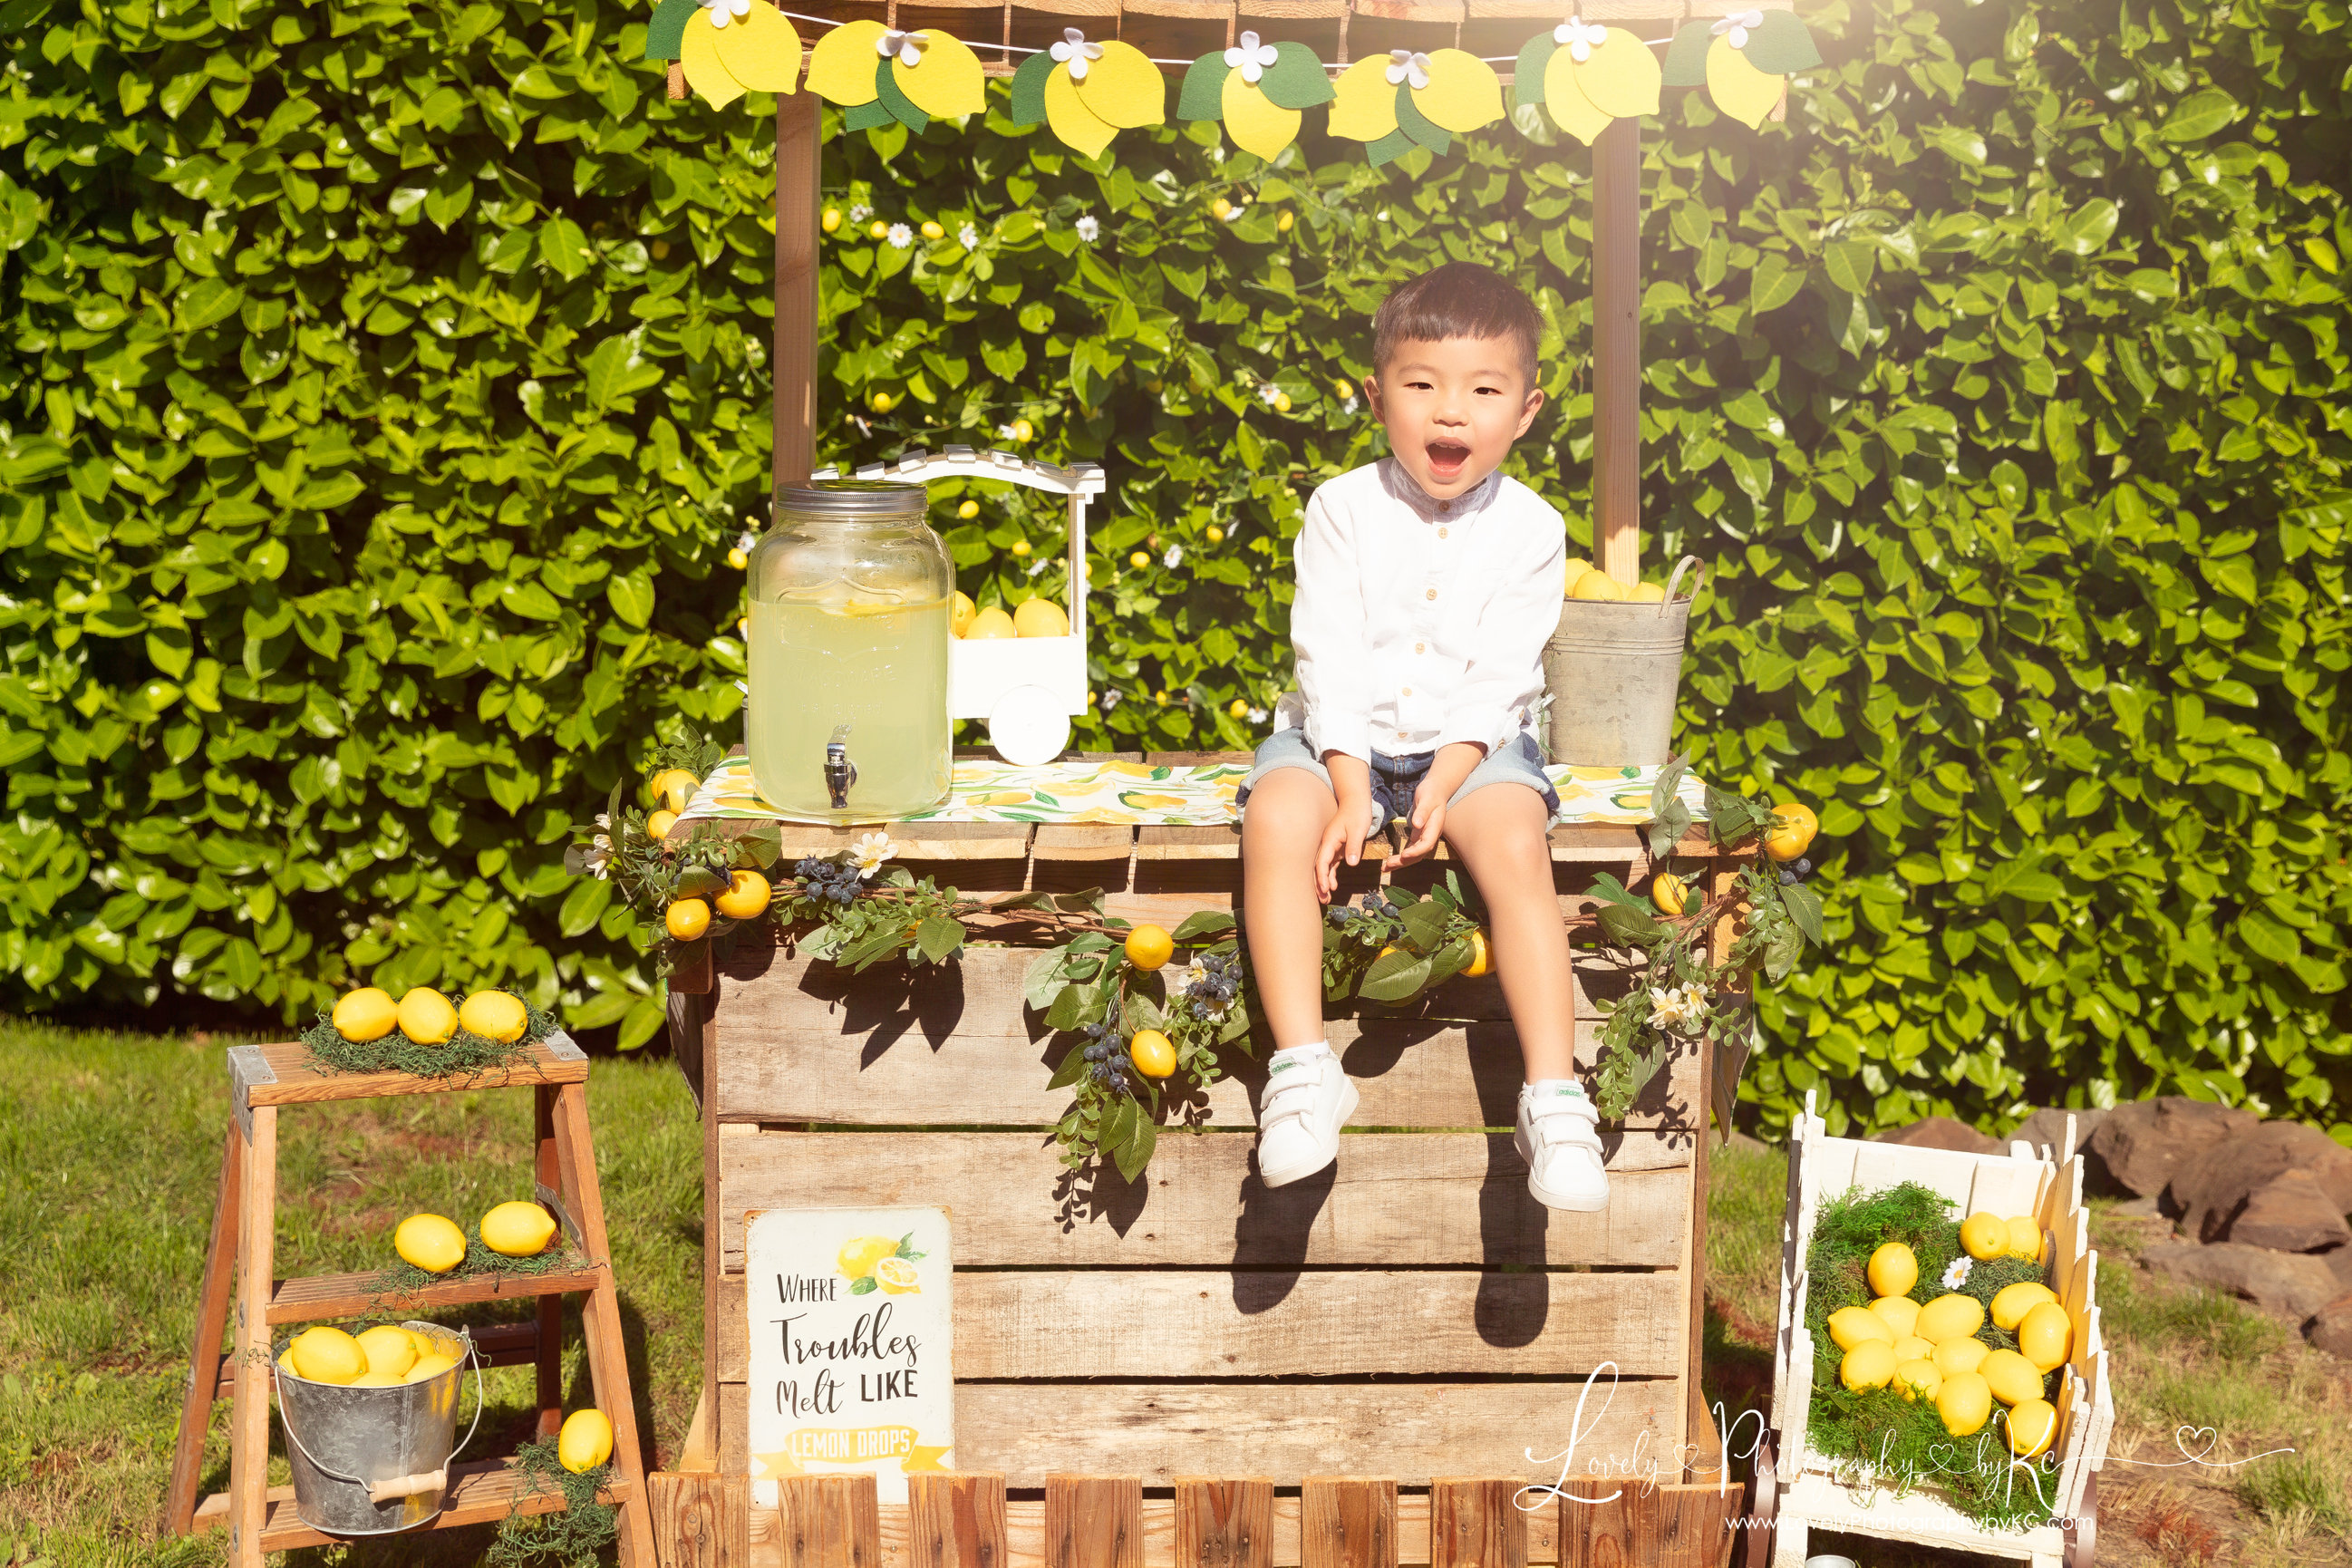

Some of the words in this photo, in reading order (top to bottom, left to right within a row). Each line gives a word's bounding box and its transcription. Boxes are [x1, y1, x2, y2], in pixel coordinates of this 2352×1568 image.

[1558, 1089, 1581, 1097] adidas
[769, 1302, 922, 1368] Troubles
[776, 1368, 845, 1418] Melt
[860, 1370, 919, 1401] LIKE
[791, 1431, 850, 1457] LEMON
[857, 1429, 911, 1457] DROPS
